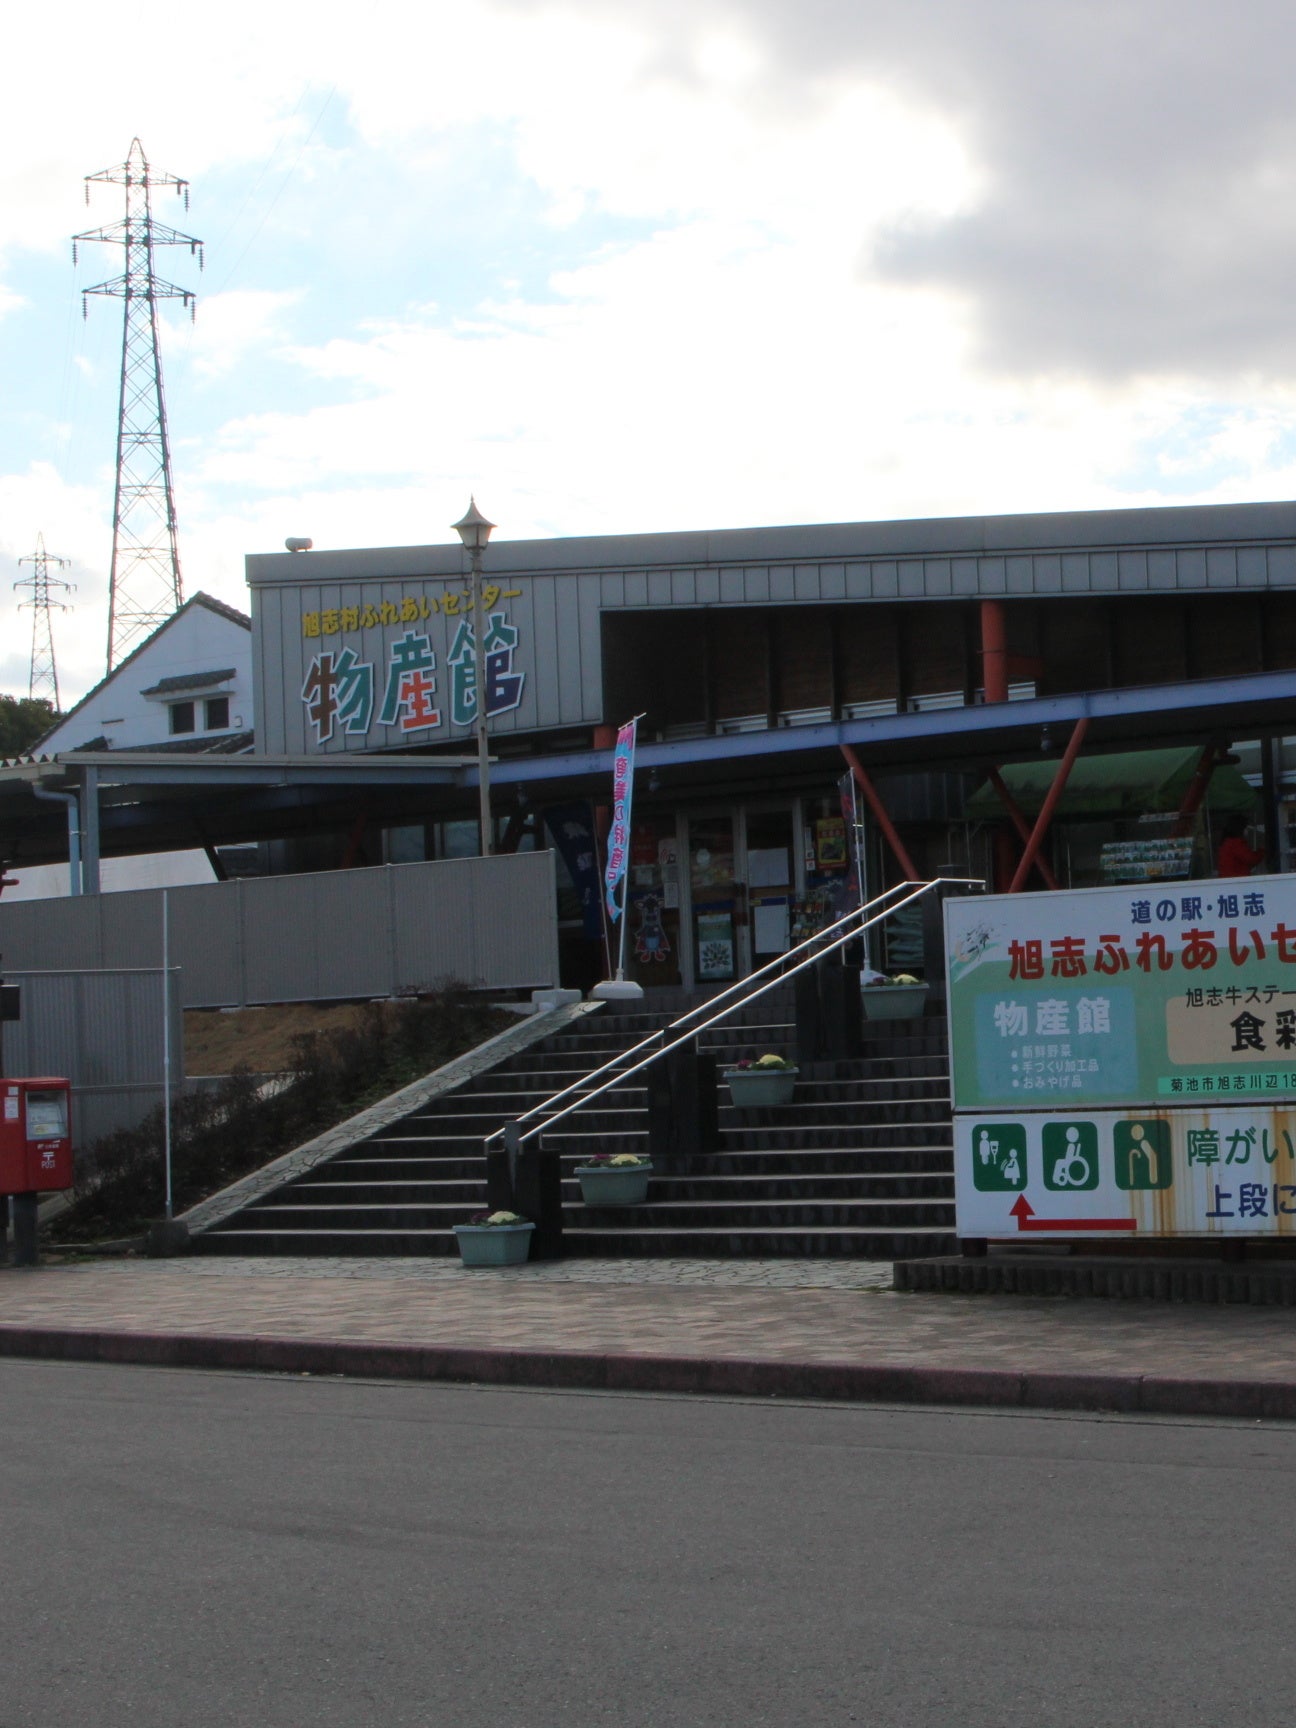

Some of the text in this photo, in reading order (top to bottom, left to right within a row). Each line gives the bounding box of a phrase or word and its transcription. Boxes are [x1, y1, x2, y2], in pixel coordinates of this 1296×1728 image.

[301, 611, 526, 745] 物産館
[1131, 892, 1266, 924] 道の駅・旭志
[993, 996, 1111, 1037] 物産館
